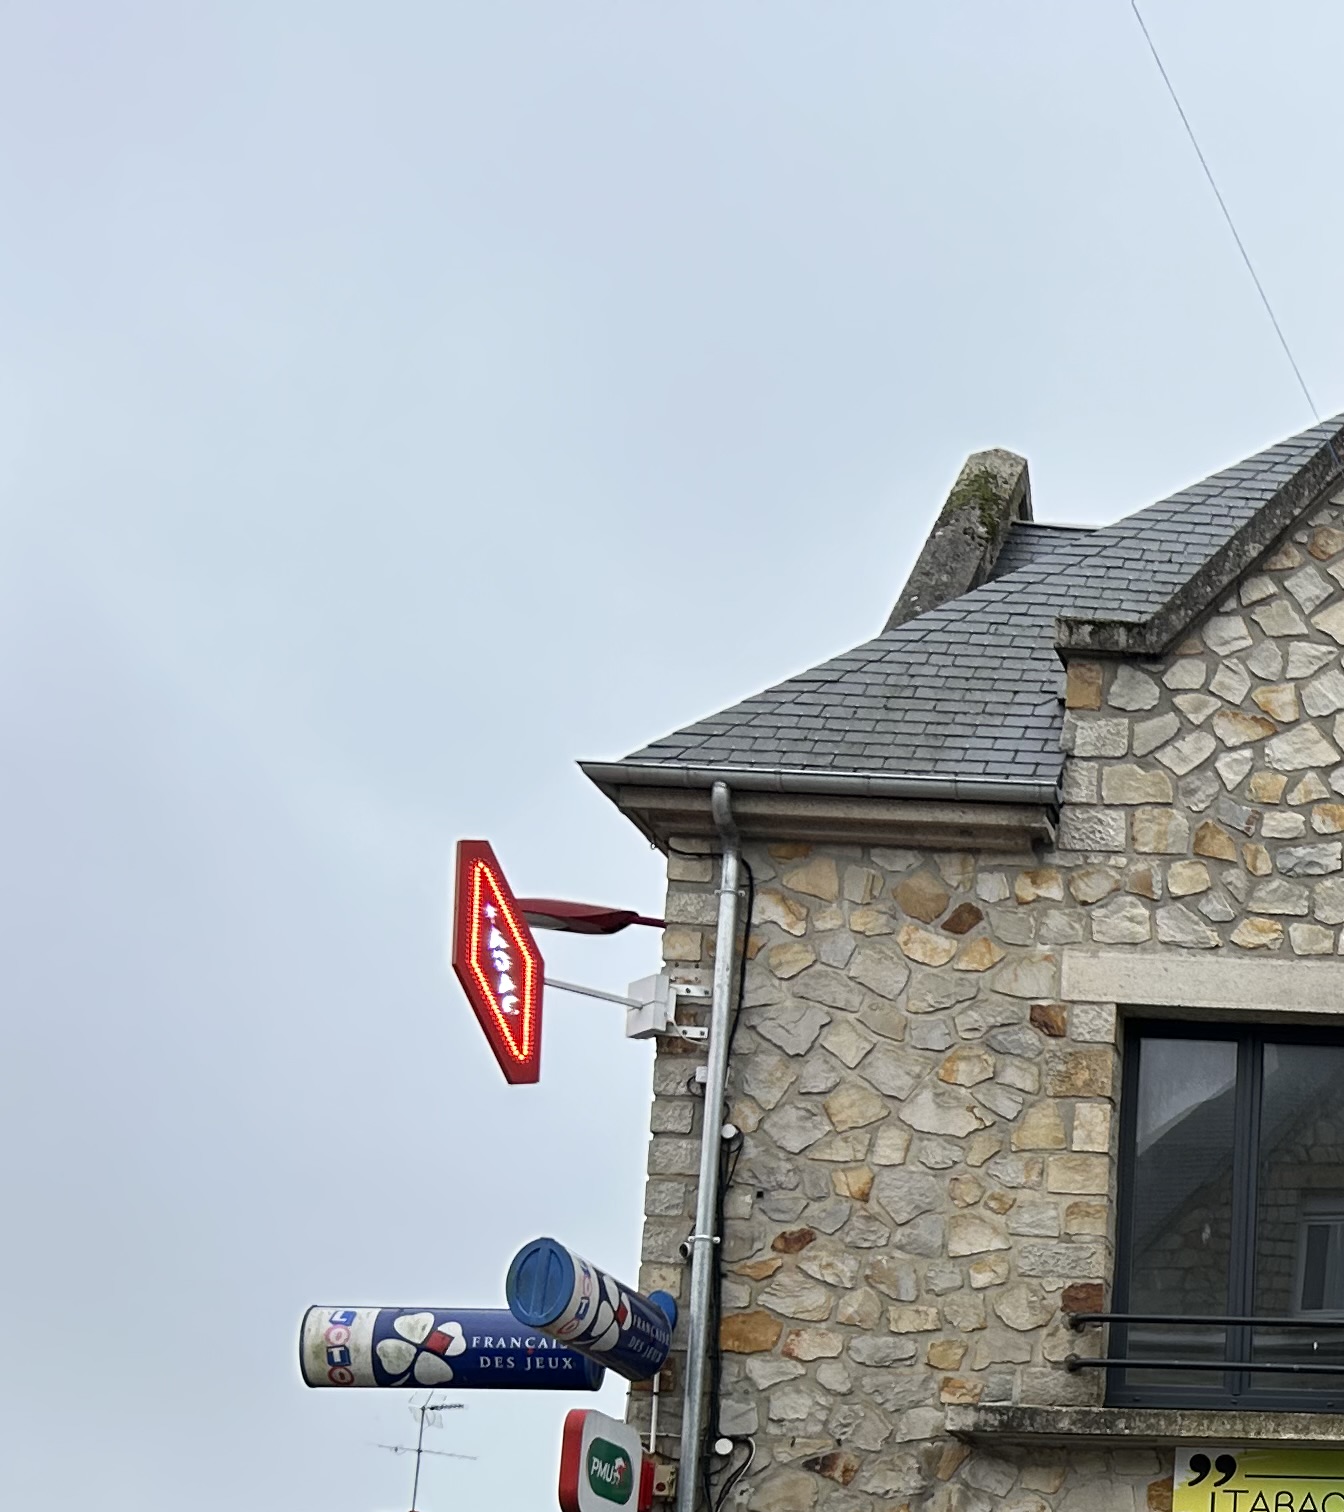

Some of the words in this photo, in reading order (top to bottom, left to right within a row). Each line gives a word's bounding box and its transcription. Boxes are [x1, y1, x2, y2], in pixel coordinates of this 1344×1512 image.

[324, 1310, 357, 1386] LOTO
[472, 1336, 568, 1354] FRANÇAI
[480, 1356, 515, 1368] DES
[525, 1357, 572, 1371] JEUX
[591, 1456, 614, 1482] PMU
